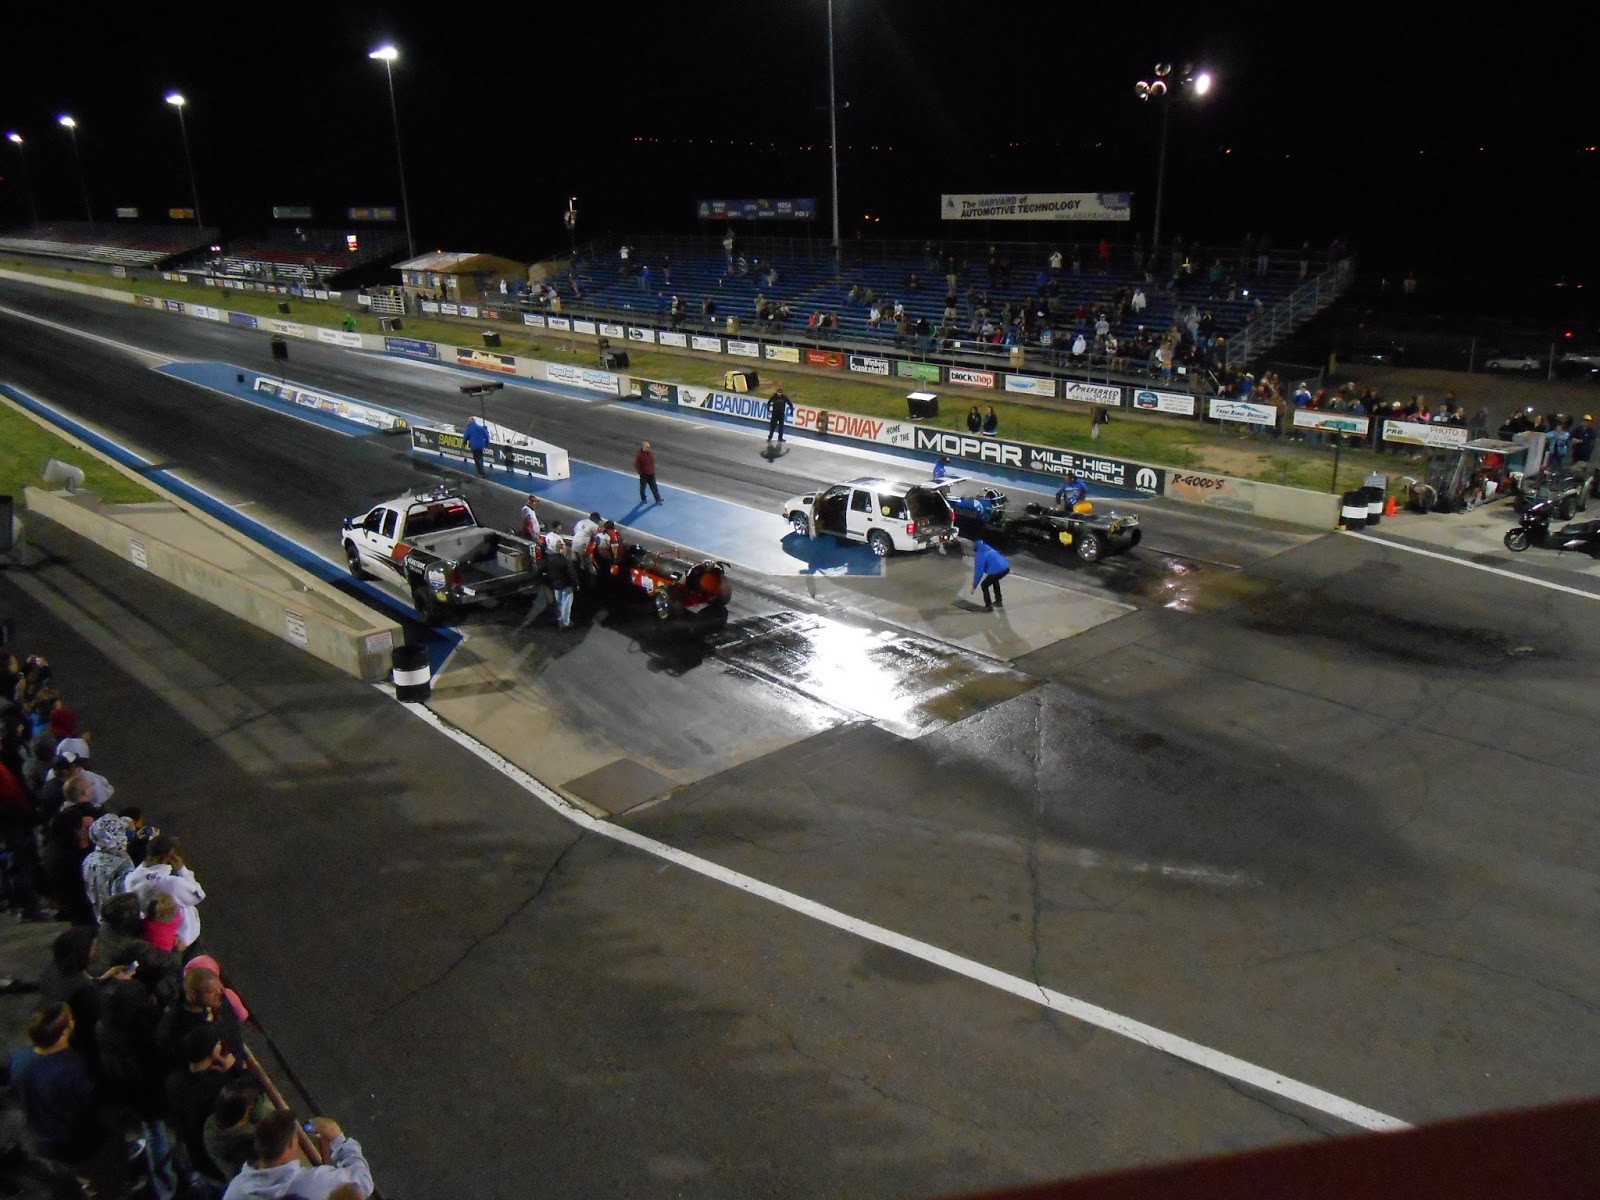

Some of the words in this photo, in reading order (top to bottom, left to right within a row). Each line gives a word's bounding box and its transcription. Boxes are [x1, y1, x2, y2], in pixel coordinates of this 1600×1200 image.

[962, 200, 976, 209] The
[979, 196, 1017, 208] HARVARD
[1018, 195, 1028, 204] of
[960, 205, 1016, 218] AUTOMOTIVE
[1017, 200, 1081, 214] TECHNOLOGY
[850, 363, 889, 376] Crankshafts
[863, 358, 889, 370] Winberg
[1076, 384, 1119, 396] PREFERRED
[713, 393, 794, 425] BANDIME
[886, 424, 901, 435] HOME
[1430, 426, 1459, 437] PHOTO
[891, 435, 898, 444] OF
[900, 432, 910, 442] THE
[917, 429, 1023, 467] MOPAR
[1043, 463, 1125, 486] NATIONALS
[1172, 473, 1225, 490] R-GOOD'S
